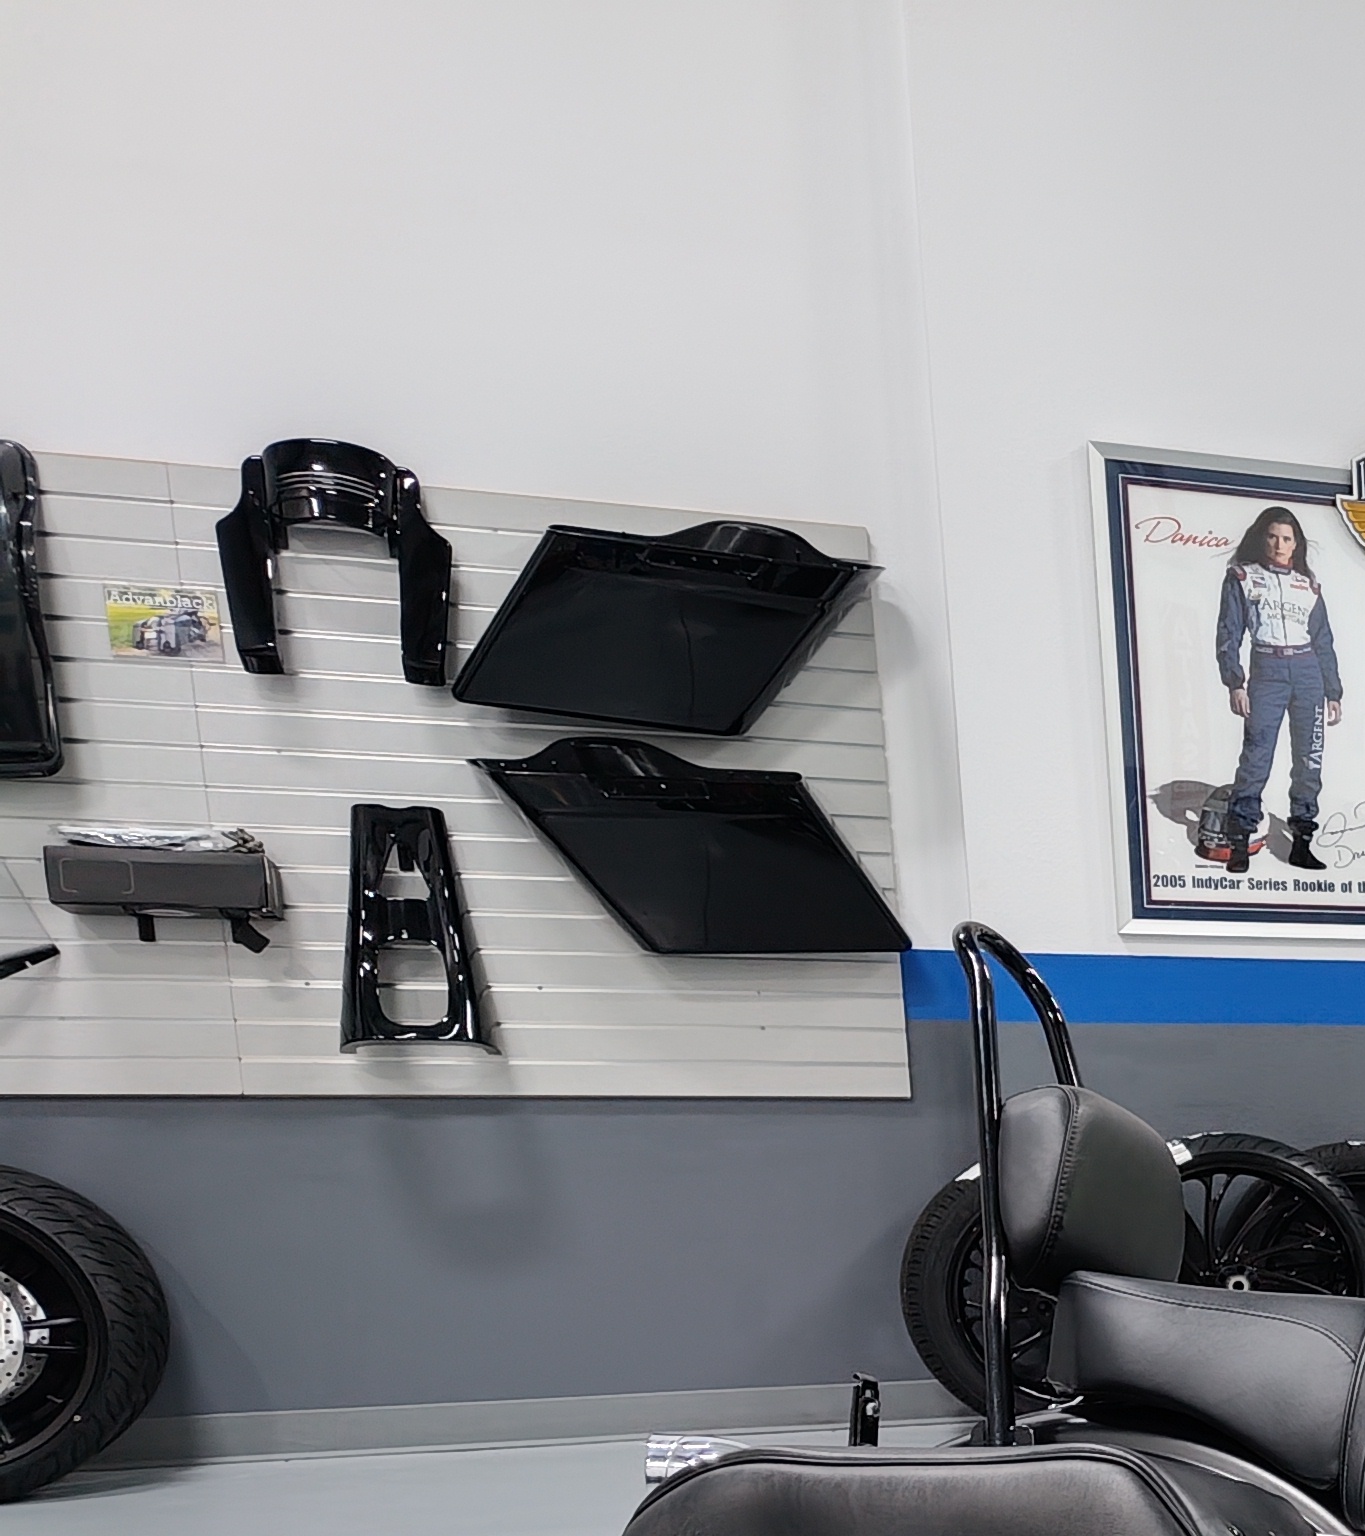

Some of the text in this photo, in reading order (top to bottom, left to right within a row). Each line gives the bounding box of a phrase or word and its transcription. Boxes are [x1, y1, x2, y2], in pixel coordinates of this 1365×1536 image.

[1134, 516, 1235, 548] Danica
[109, 589, 216, 610] Advanblack
[1309, 705, 1324, 760] ARGENT
[1153, 874, 1187, 889] 2005
[1192, 875, 1242, 891] IndyCar
[1248, 877, 1289, 892] Series
[1293, 879, 1336, 893] Rookie
[1341, 880, 1354, 894] of
